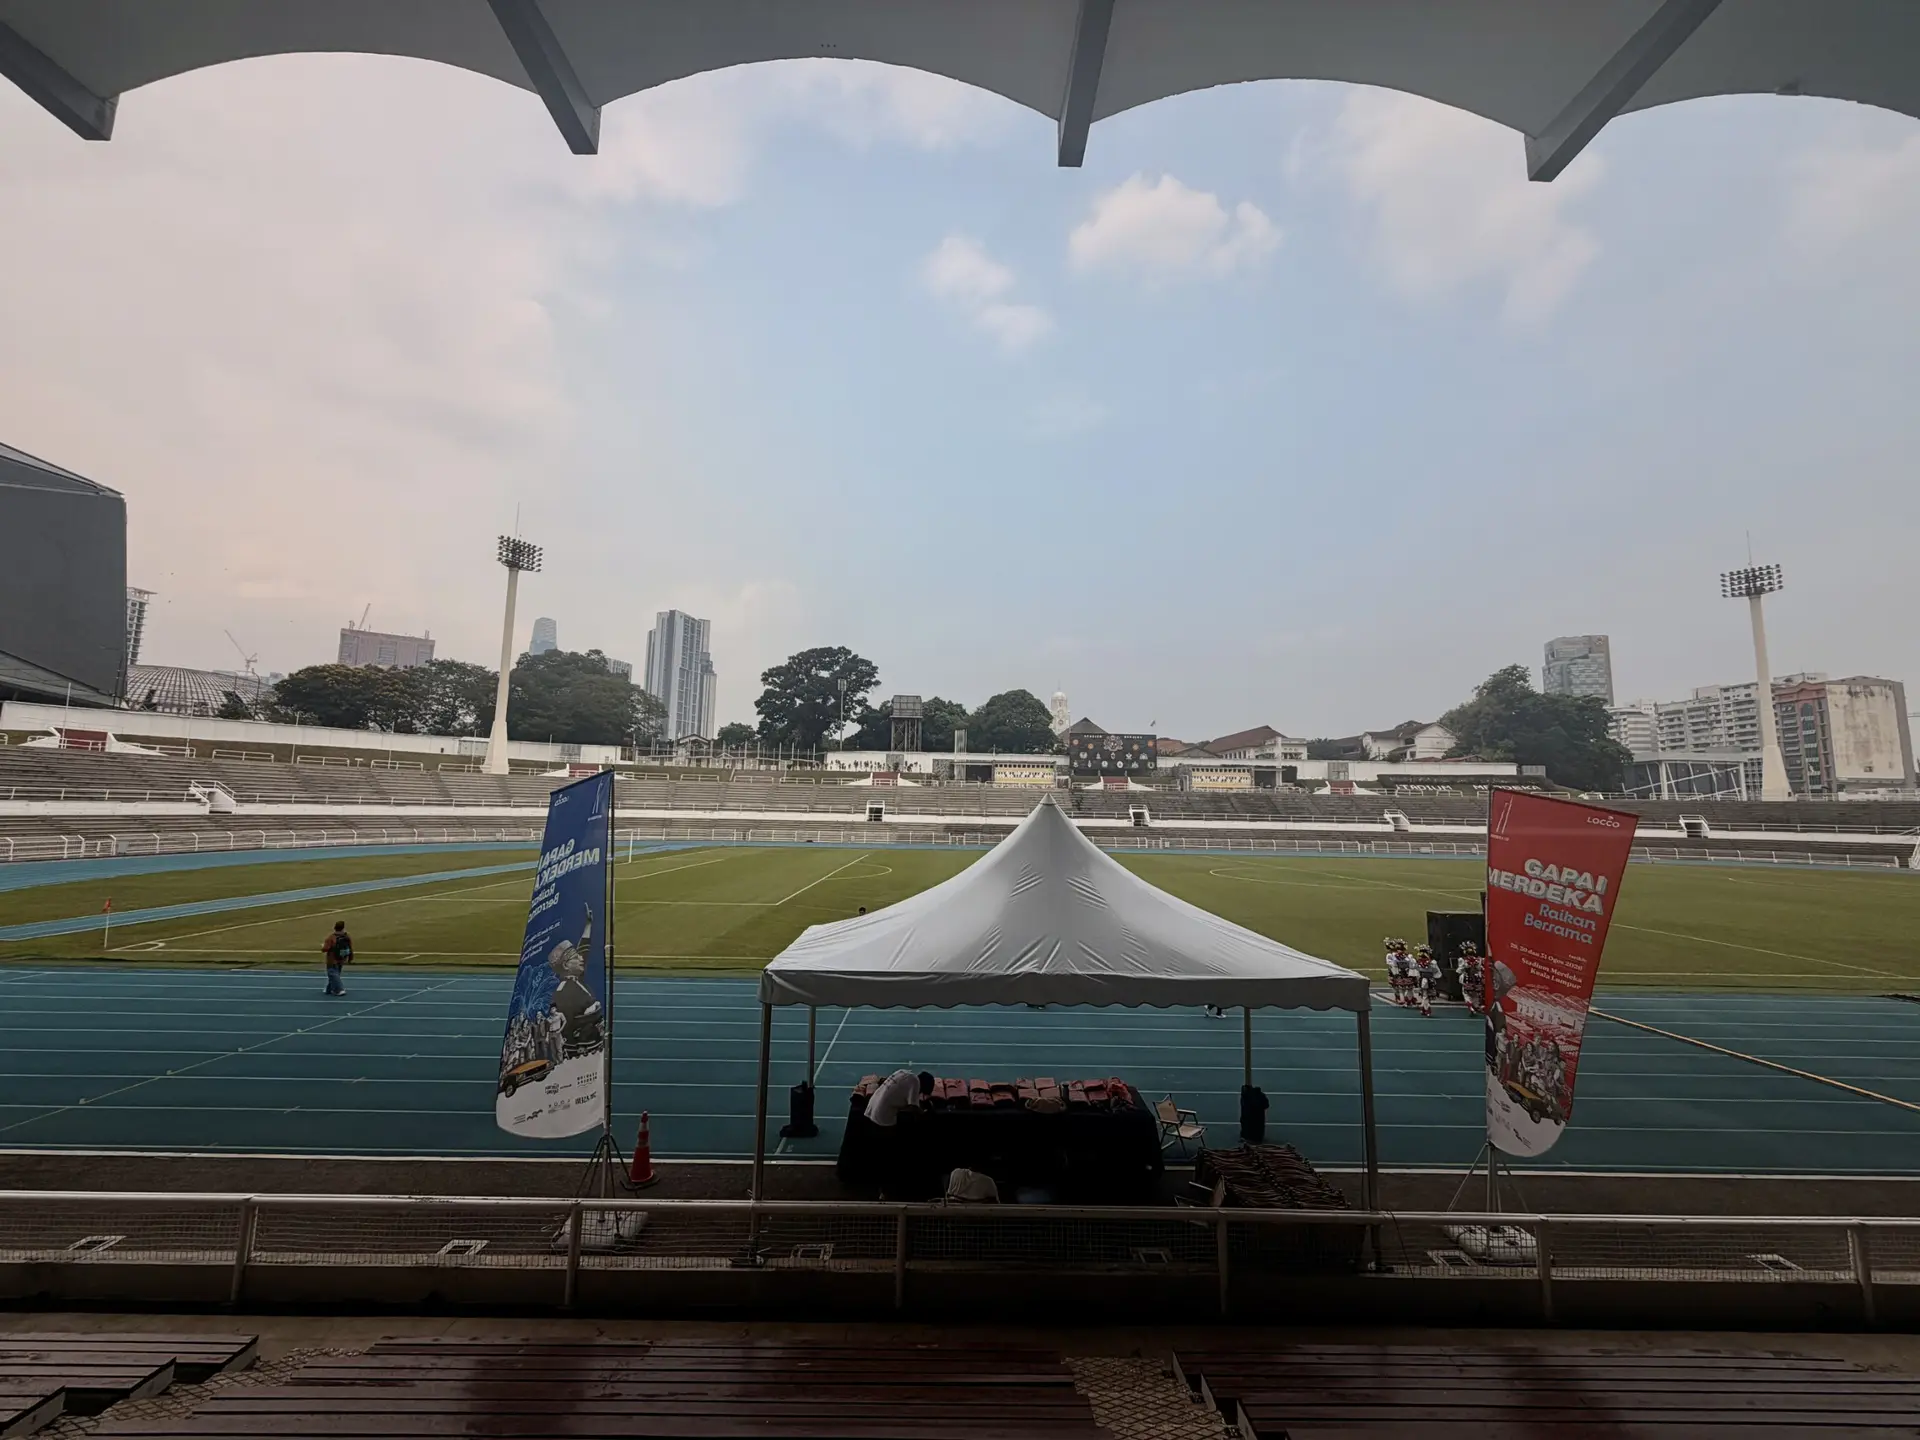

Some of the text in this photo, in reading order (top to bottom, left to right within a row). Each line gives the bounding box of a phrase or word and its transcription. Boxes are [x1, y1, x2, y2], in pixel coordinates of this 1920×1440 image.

[1586, 816, 1621, 828] LOCCO
[1488, 866, 1604, 916] MERDEKA
[1524, 858, 1608, 896] GAPAI
[1523, 912, 1593, 944] Bersama
[1539, 903, 1596, 931] Raikan
[1521, 957, 1583, 983] Stadium Merdeka
[1530, 968, 1550, 979] Kuala
[1551, 975, 1582, 989] Lumpur
